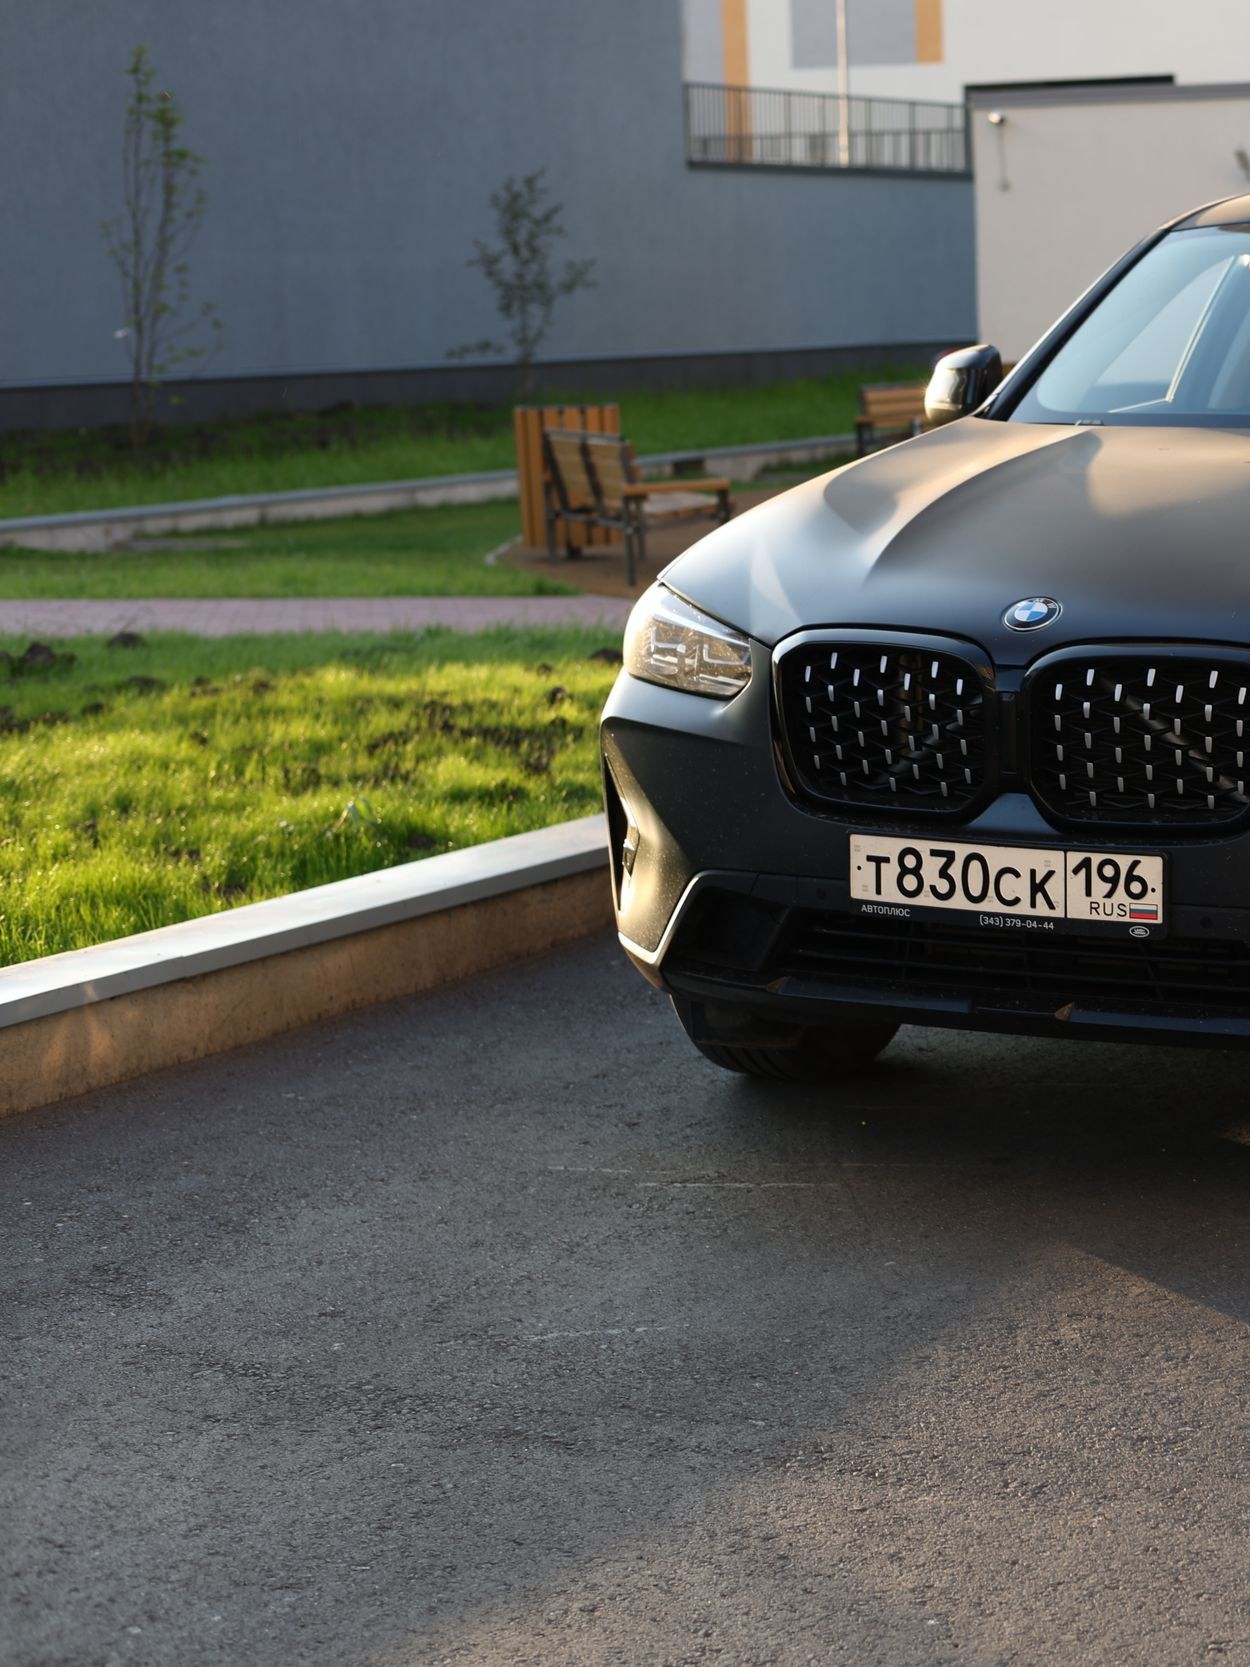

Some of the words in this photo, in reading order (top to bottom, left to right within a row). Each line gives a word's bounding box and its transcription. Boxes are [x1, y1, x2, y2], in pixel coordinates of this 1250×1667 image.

[1071, 856, 1148, 900] 196
[861, 904, 910, 917] АВТОПЛЮС
[1089, 901, 1127, 918] RUS
[979, 914, 1003, 927] (343)
[1005, 917, 1055, 930] 379-04-44
